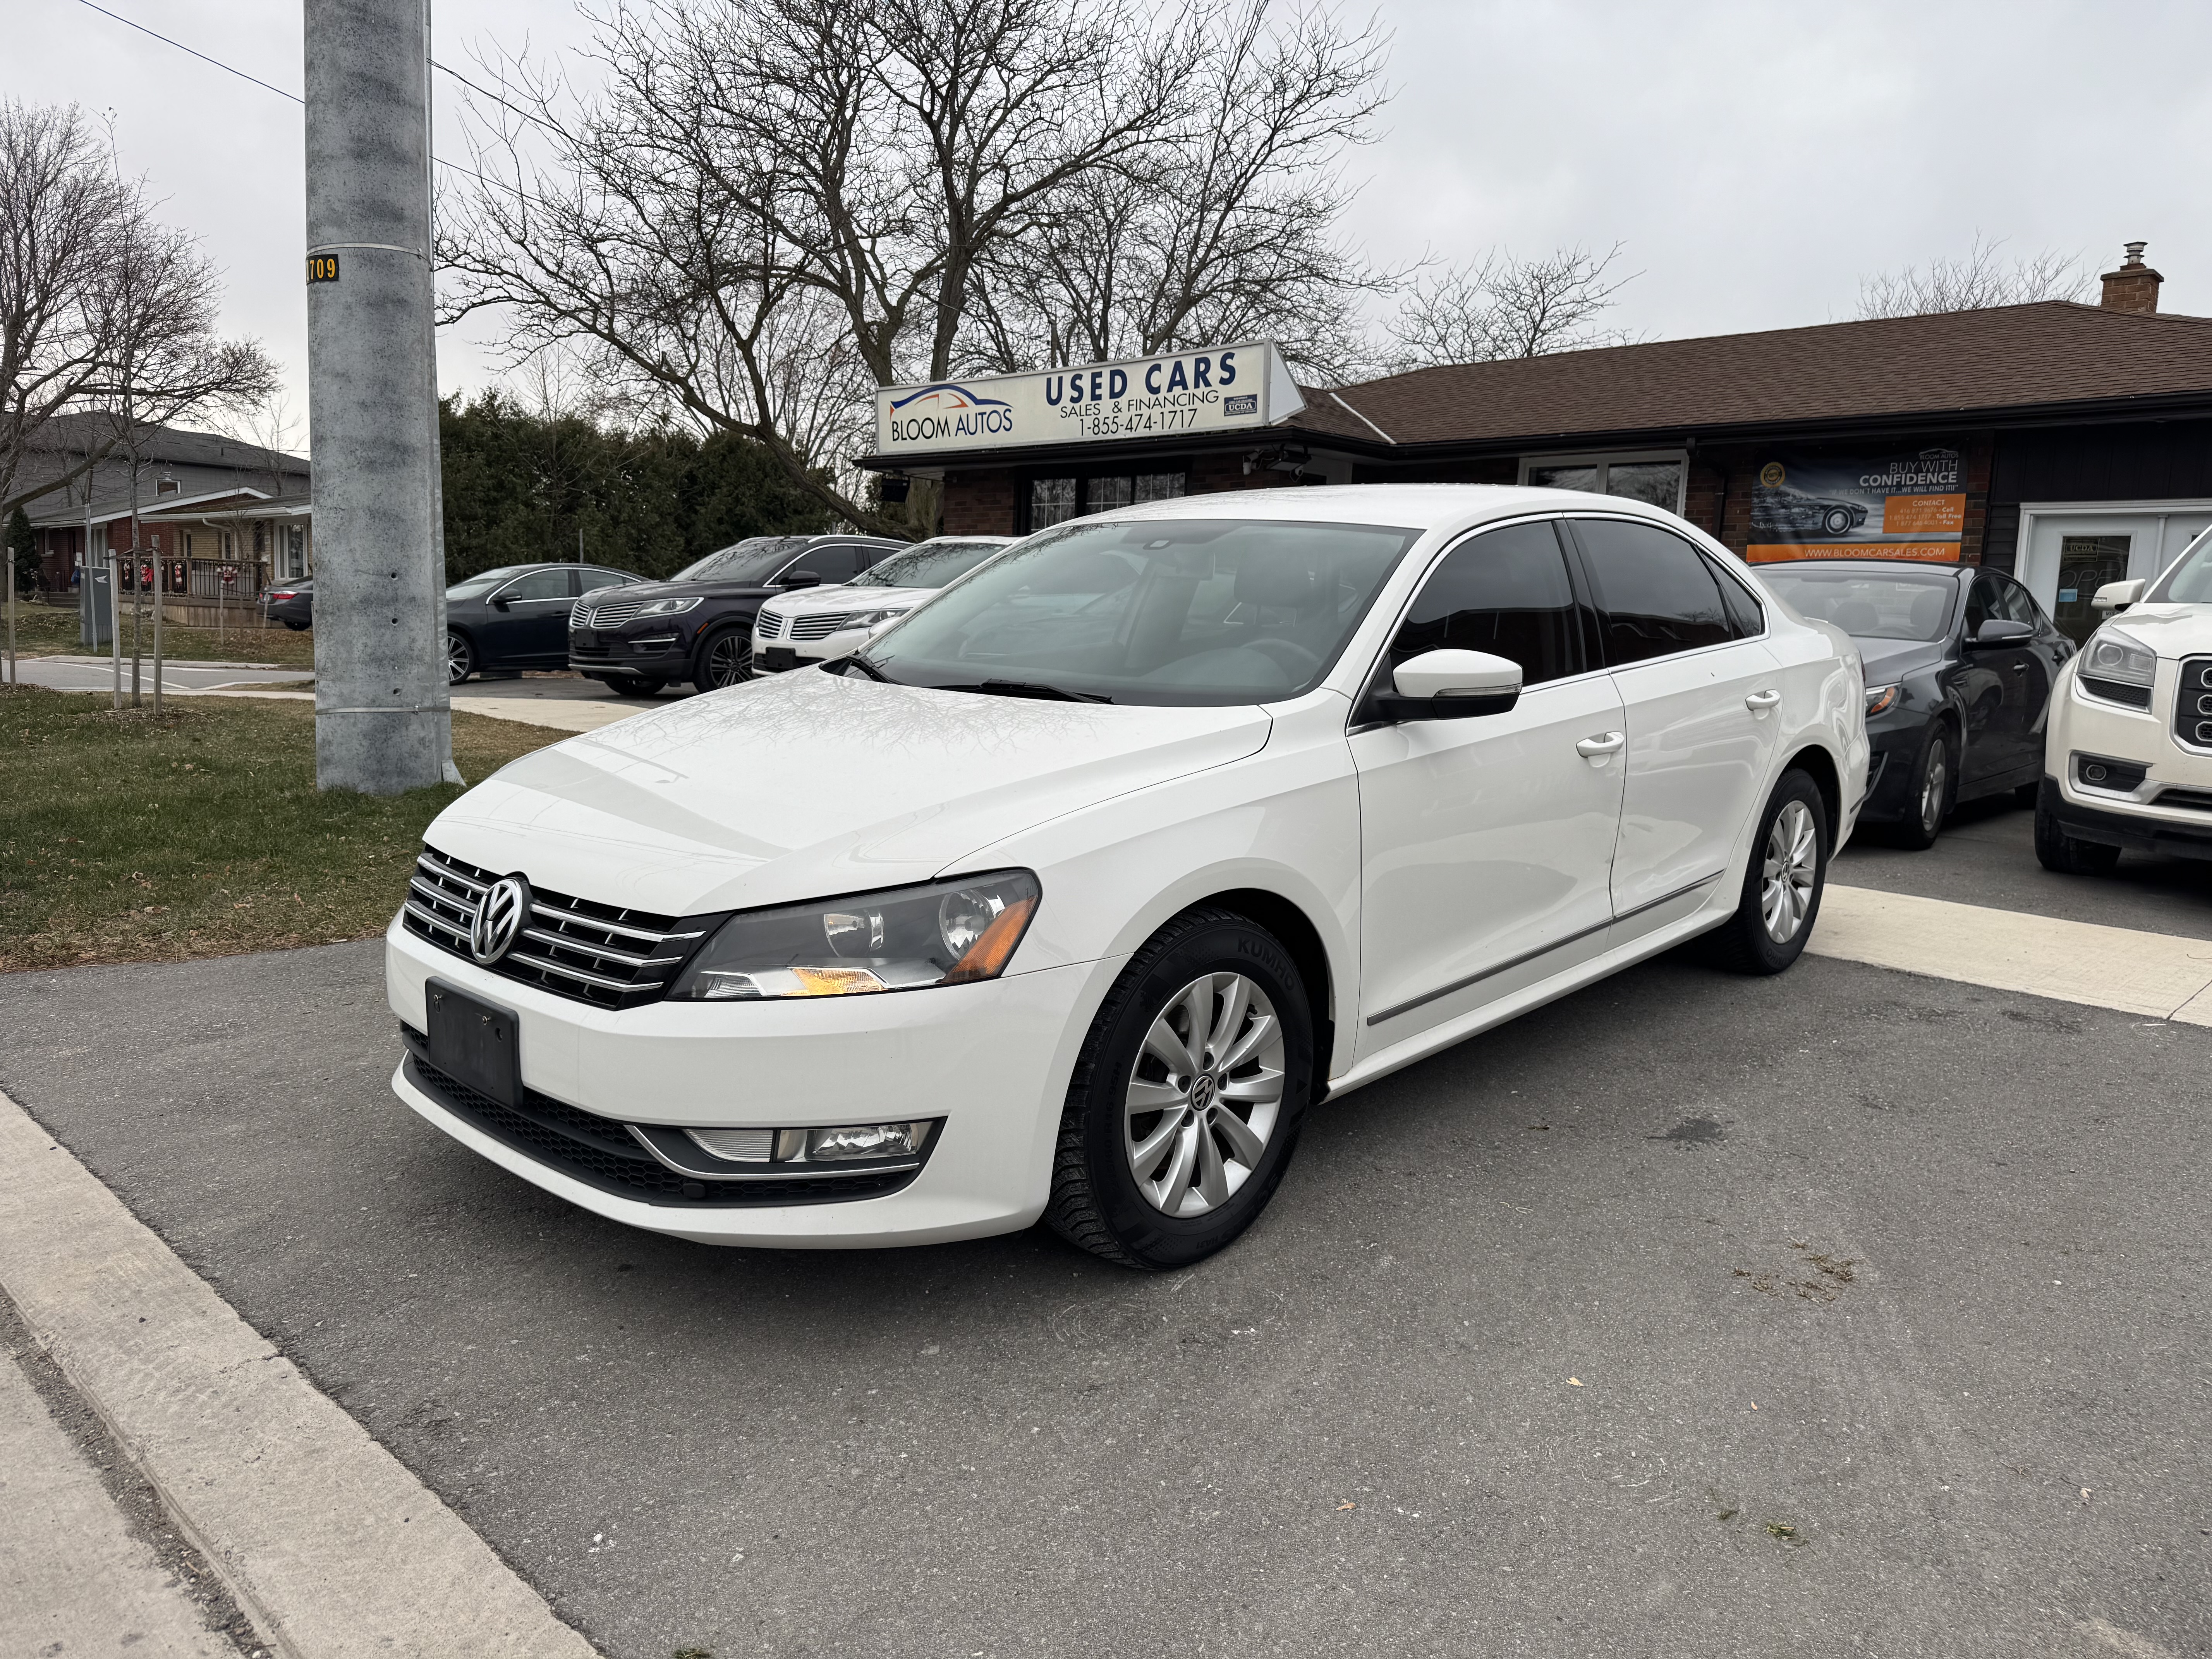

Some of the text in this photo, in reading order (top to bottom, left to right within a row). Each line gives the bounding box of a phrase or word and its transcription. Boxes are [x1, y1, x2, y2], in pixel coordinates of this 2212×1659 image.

[1046, 352, 1236, 406] USED CARS
[1060, 390, 1219, 418] SALES & FINANCING
[1229, 403, 1253, 411] UCDA
[892, 408, 1013, 441] BLOOM AUTOS
[1080, 408, 1198, 436] 1-855-474-1717
[1860, 471, 1958, 487] CONFIDENCE
[1890, 460, 1958, 474] BUY WITH
[1805, 548, 1944, 557] WWW.BLOOMCARSALES.COM
[1237, 936, 1294, 990] KUMHO
[1108, 1061, 1122, 1096] 95H
[1104, 1101, 1114, 1134] R16
